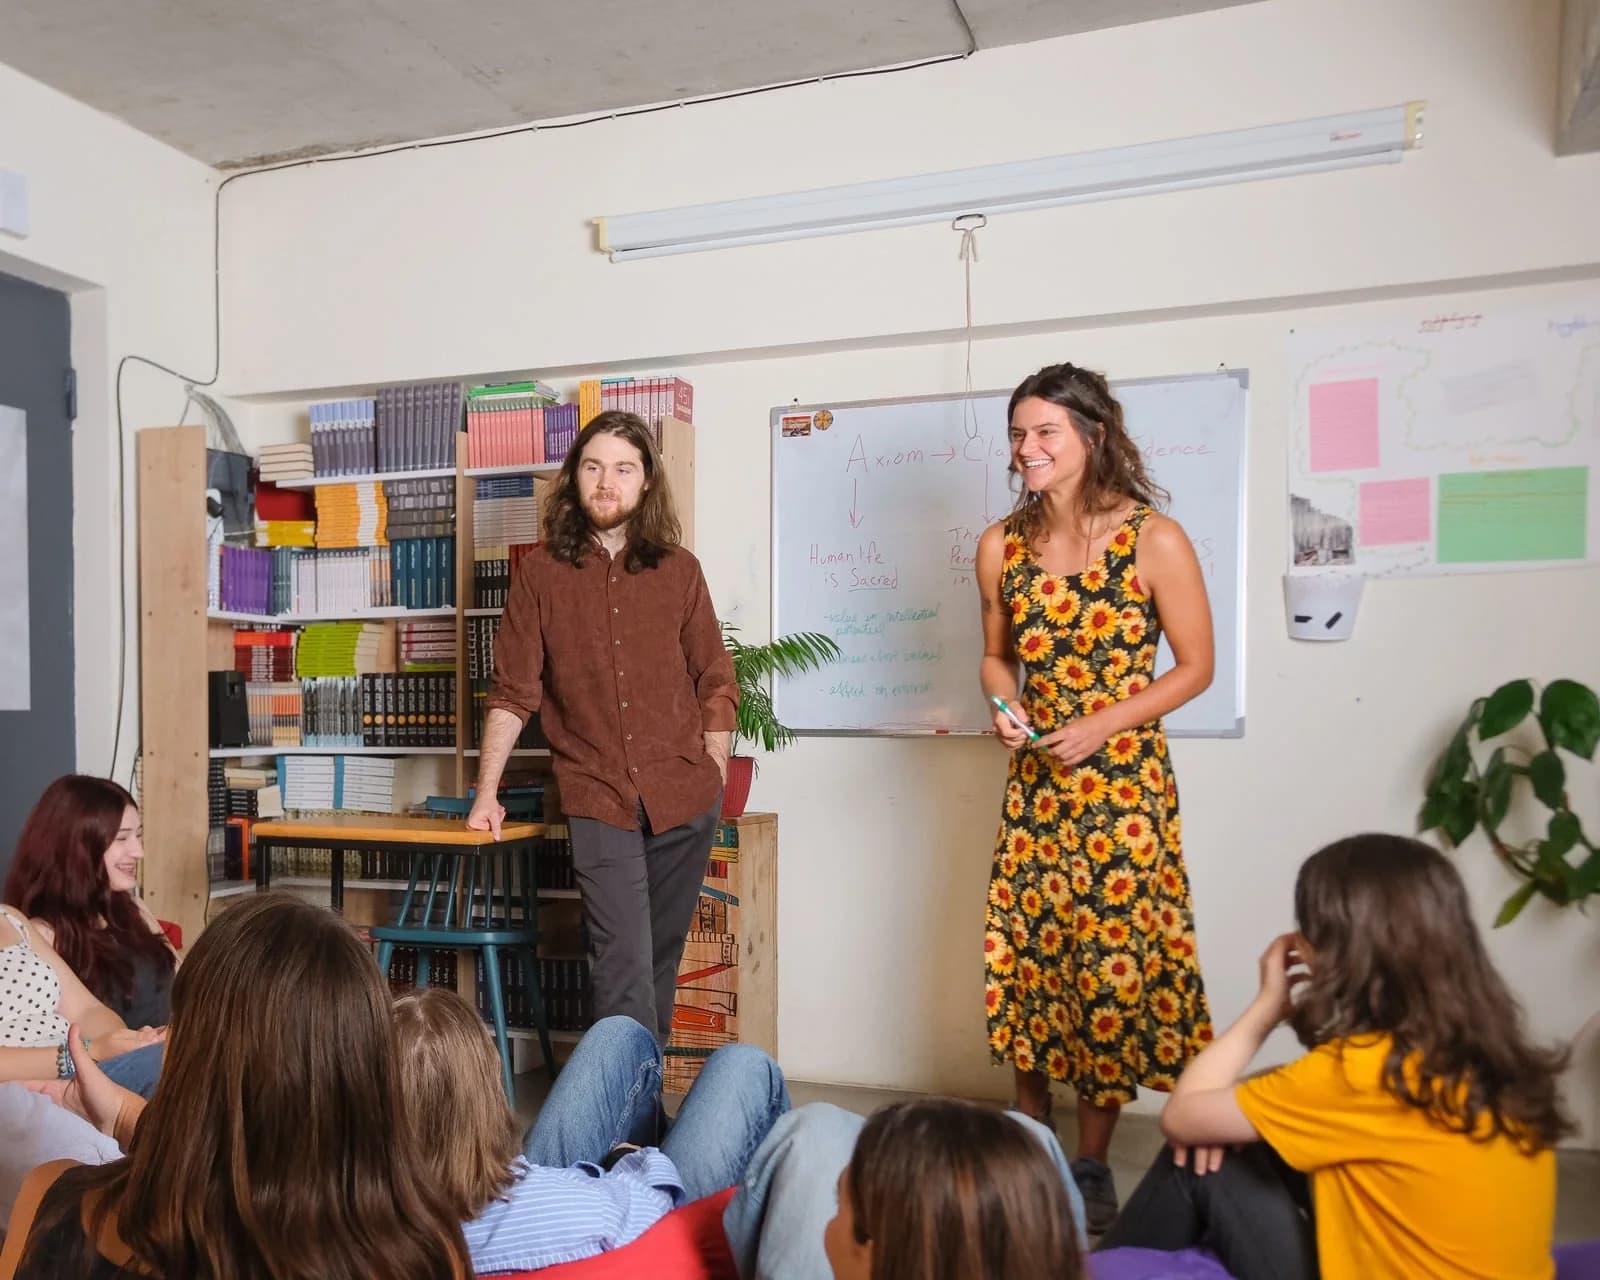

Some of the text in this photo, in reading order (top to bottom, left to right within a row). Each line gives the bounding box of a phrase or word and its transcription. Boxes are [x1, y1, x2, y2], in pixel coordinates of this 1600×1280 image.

[846, 433, 924, 473] Axiom
[963, 434, 1008, 462] Cla
[1144, 437, 1216, 459] dence
[947, 527, 979, 543] Th
[809, 543, 855, 566] Human
[824, 567, 899, 590] is Sacred
